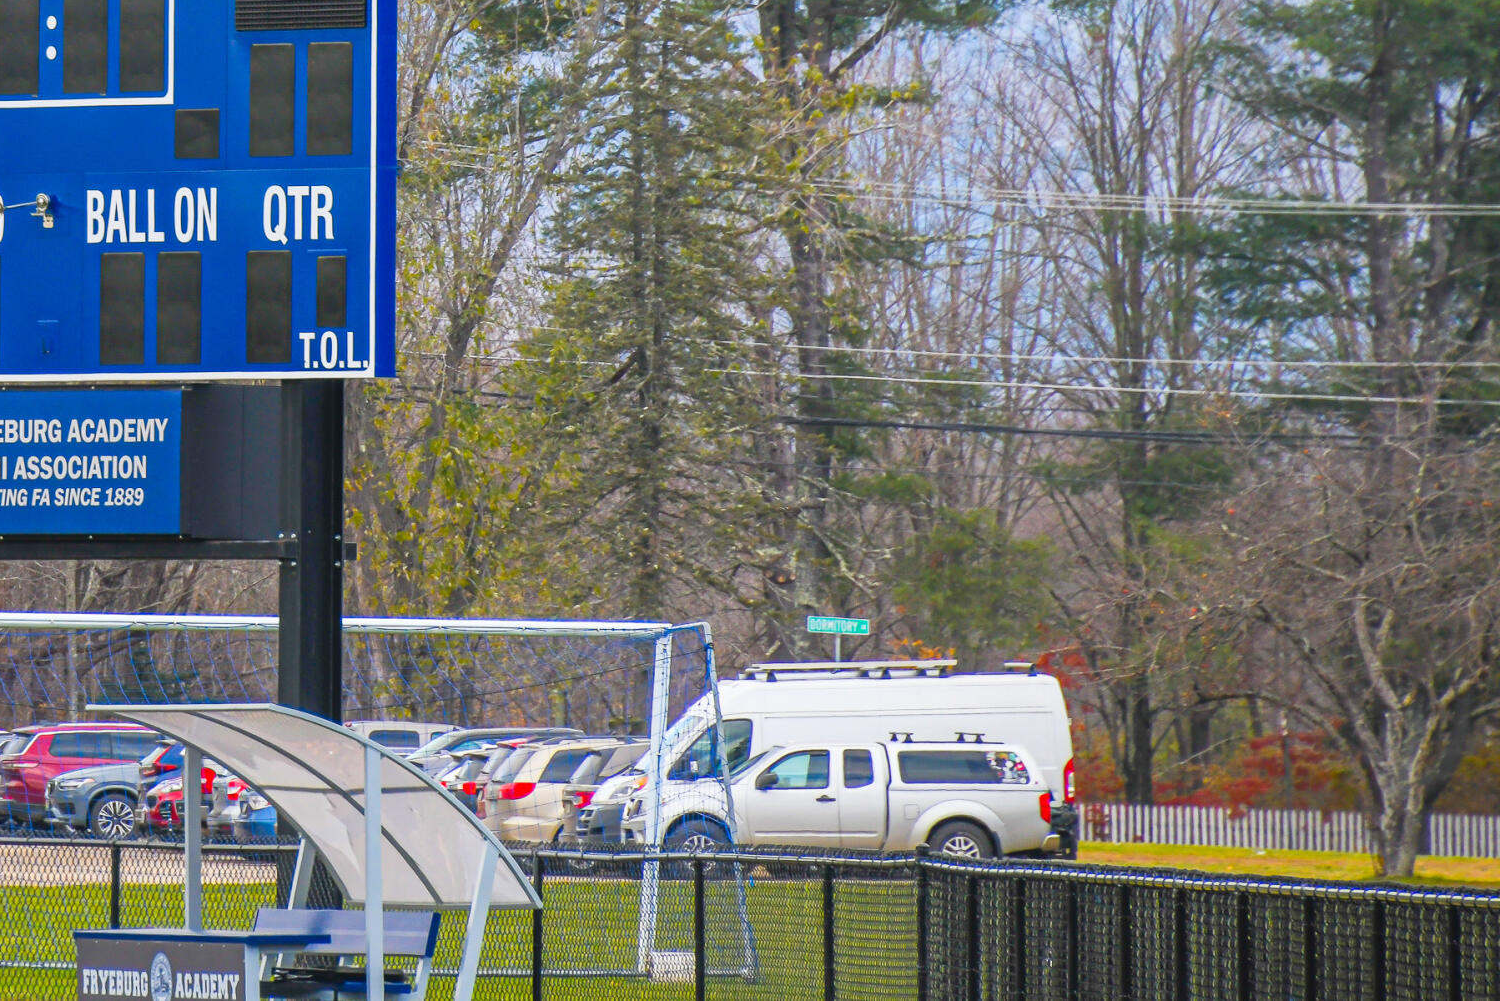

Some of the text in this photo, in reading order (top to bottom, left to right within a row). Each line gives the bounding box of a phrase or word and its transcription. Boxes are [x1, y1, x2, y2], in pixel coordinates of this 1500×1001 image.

[86, 186, 218, 244] BALL ON
[263, 184, 335, 246] QTR
[299, 330, 369, 370] T.O.L.
[67, 418, 169, 443] ACADEMY
[13, 455, 147, 480] ASSOCIATION
[31, 488, 51, 506] FA
[54, 487, 102, 507] SINCE
[104, 487, 145, 506] 1889
[82, 968, 149, 998] FRYEBURG
[174, 972, 240, 1000] ACADEMY
